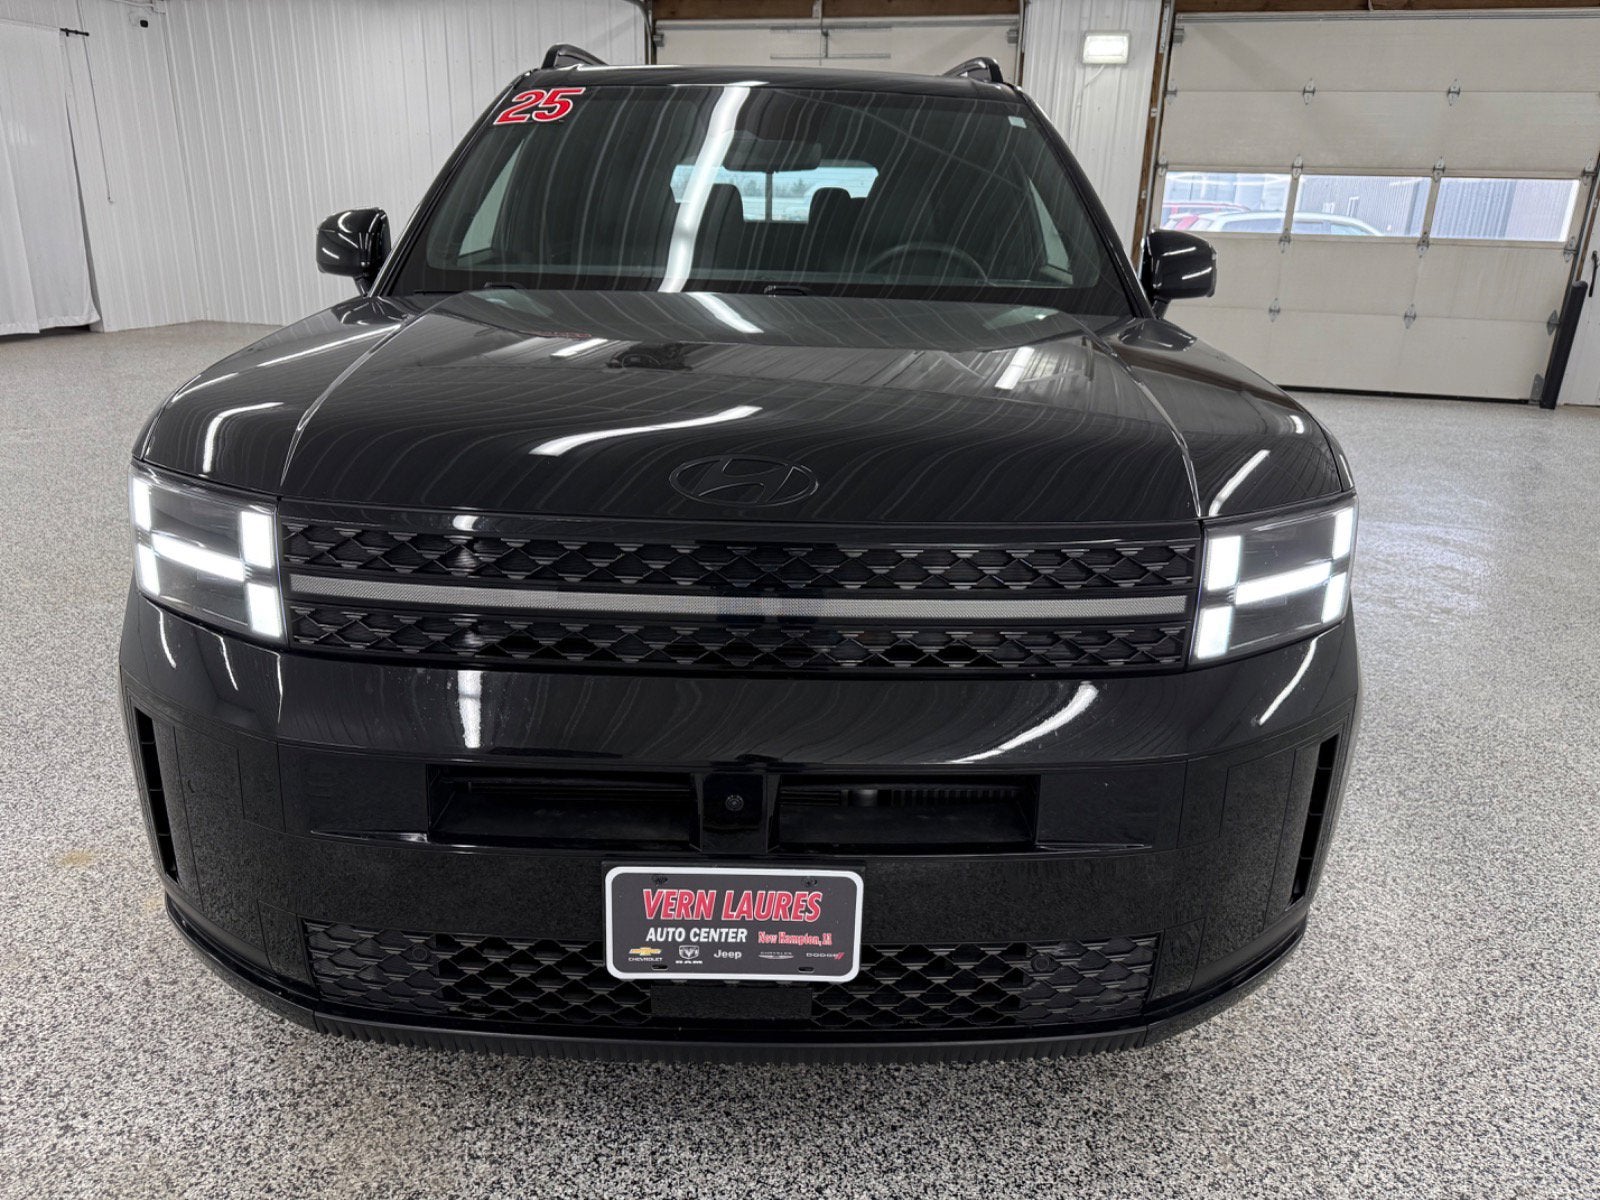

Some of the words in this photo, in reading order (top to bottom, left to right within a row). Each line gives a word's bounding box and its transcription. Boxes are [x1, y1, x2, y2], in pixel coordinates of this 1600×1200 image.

[493, 87, 587, 125] 25
[642, 889, 716, 920] VERN
[721, 890, 823, 922] LAURES
[645, 927, 686, 942] AUTO
[689, 927, 748, 943] CENTER
[757, 931, 778, 943] New
[713, 949, 742, 960] Jeep
